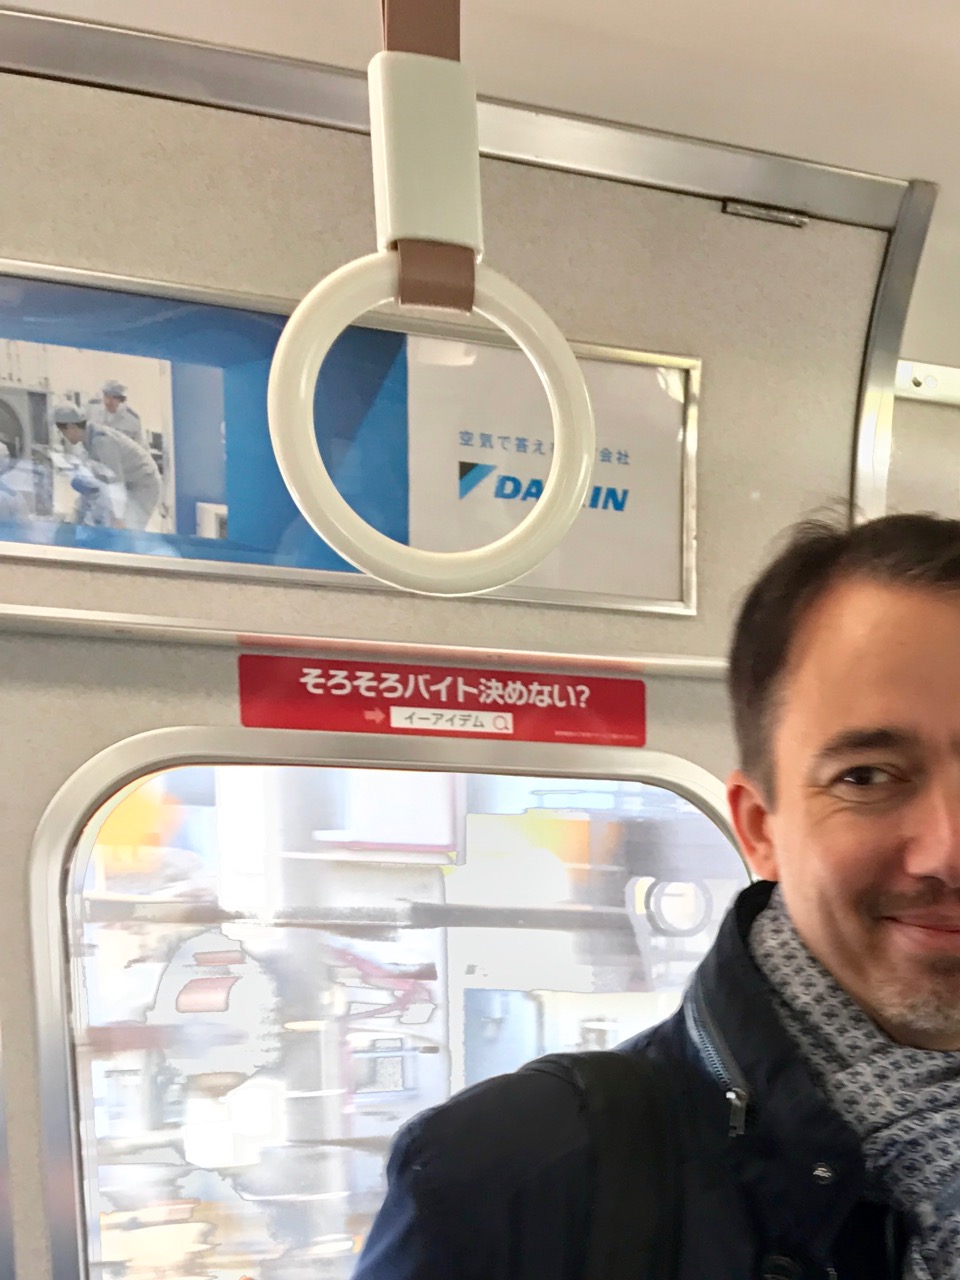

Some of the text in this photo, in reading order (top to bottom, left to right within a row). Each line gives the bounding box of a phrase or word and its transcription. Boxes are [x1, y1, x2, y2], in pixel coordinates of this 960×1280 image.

[458, 430, 631, 466] 空気で答え会社
[494, 474, 629, 512] DAIN
[299, 667, 591, 708] そろそろバイト決めない?
[404, 711, 485, 729] イーアイデム
